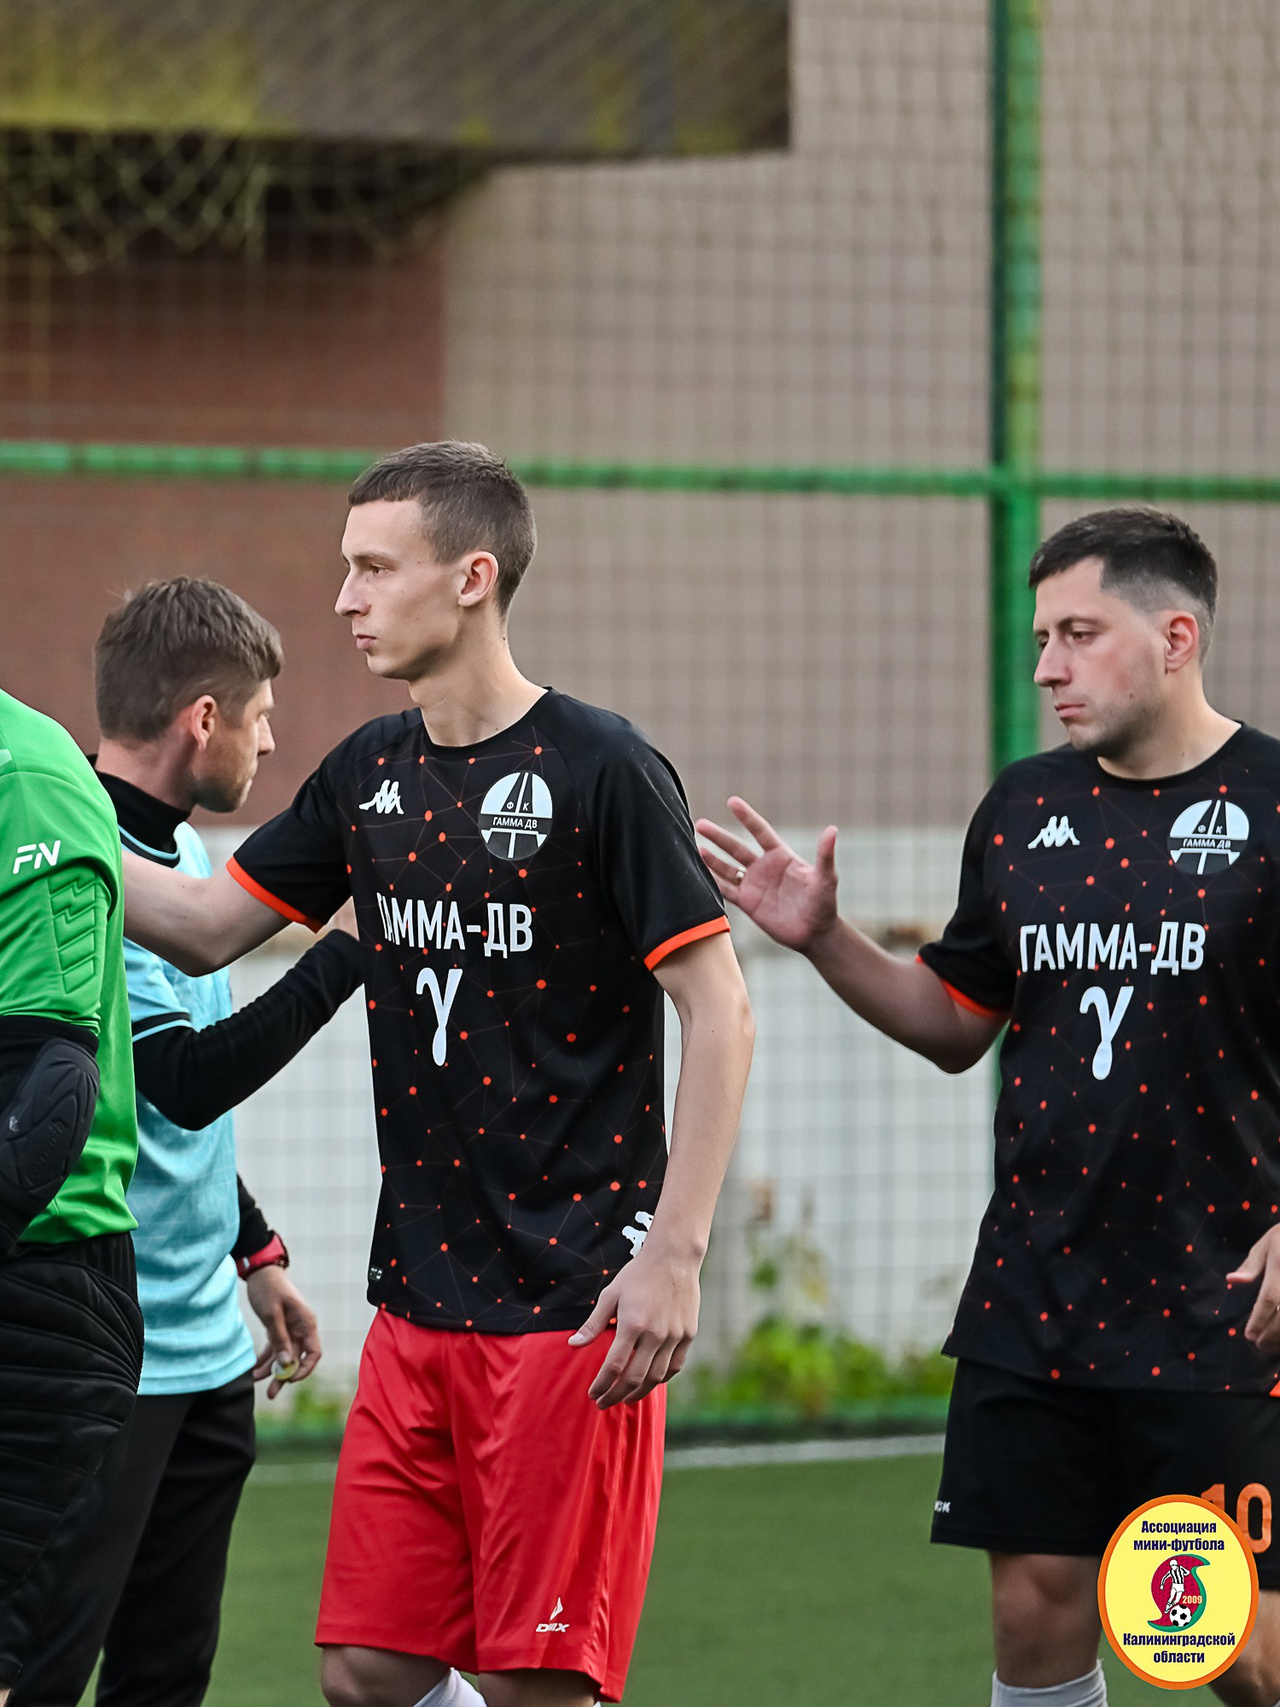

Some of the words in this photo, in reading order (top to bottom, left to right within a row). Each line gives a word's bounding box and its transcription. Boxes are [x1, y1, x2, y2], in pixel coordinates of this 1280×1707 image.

[506, 801, 515, 810] Ф
[522, 802, 530, 811] К
[492, 816, 523, 828] ГАММА
[524, 818, 538, 830] ДВ
[1182, 838, 1216, 848] ГАММА
[1216, 839, 1231, 850] ДВ
[12, 840, 61, 874] FN
[1020, 921, 1206, 976] ГАММА-ДВ
[1201, 1482, 1272, 1553] 10
